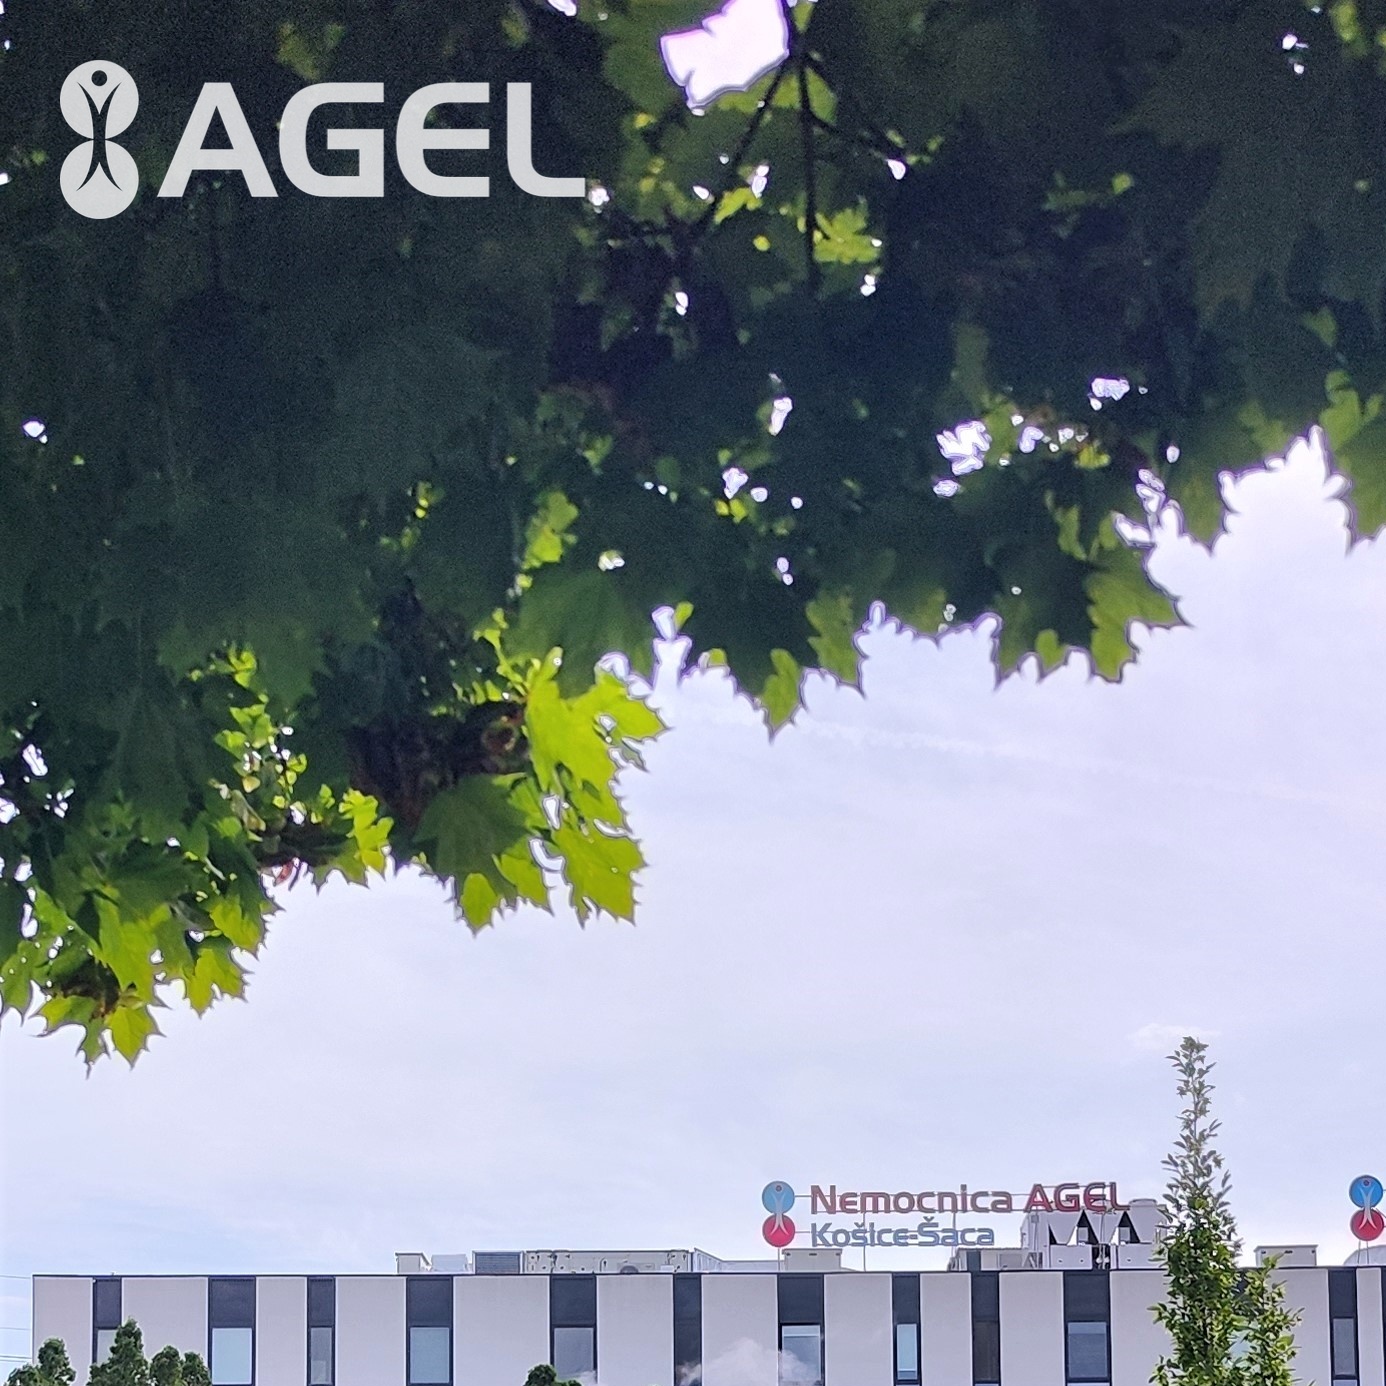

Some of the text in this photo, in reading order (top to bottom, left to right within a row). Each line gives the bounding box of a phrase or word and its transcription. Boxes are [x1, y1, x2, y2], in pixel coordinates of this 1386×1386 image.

[810, 1181, 1131, 1214] Nemocnica AGEL
[810, 1216, 995, 1247] Košice-Šaca
